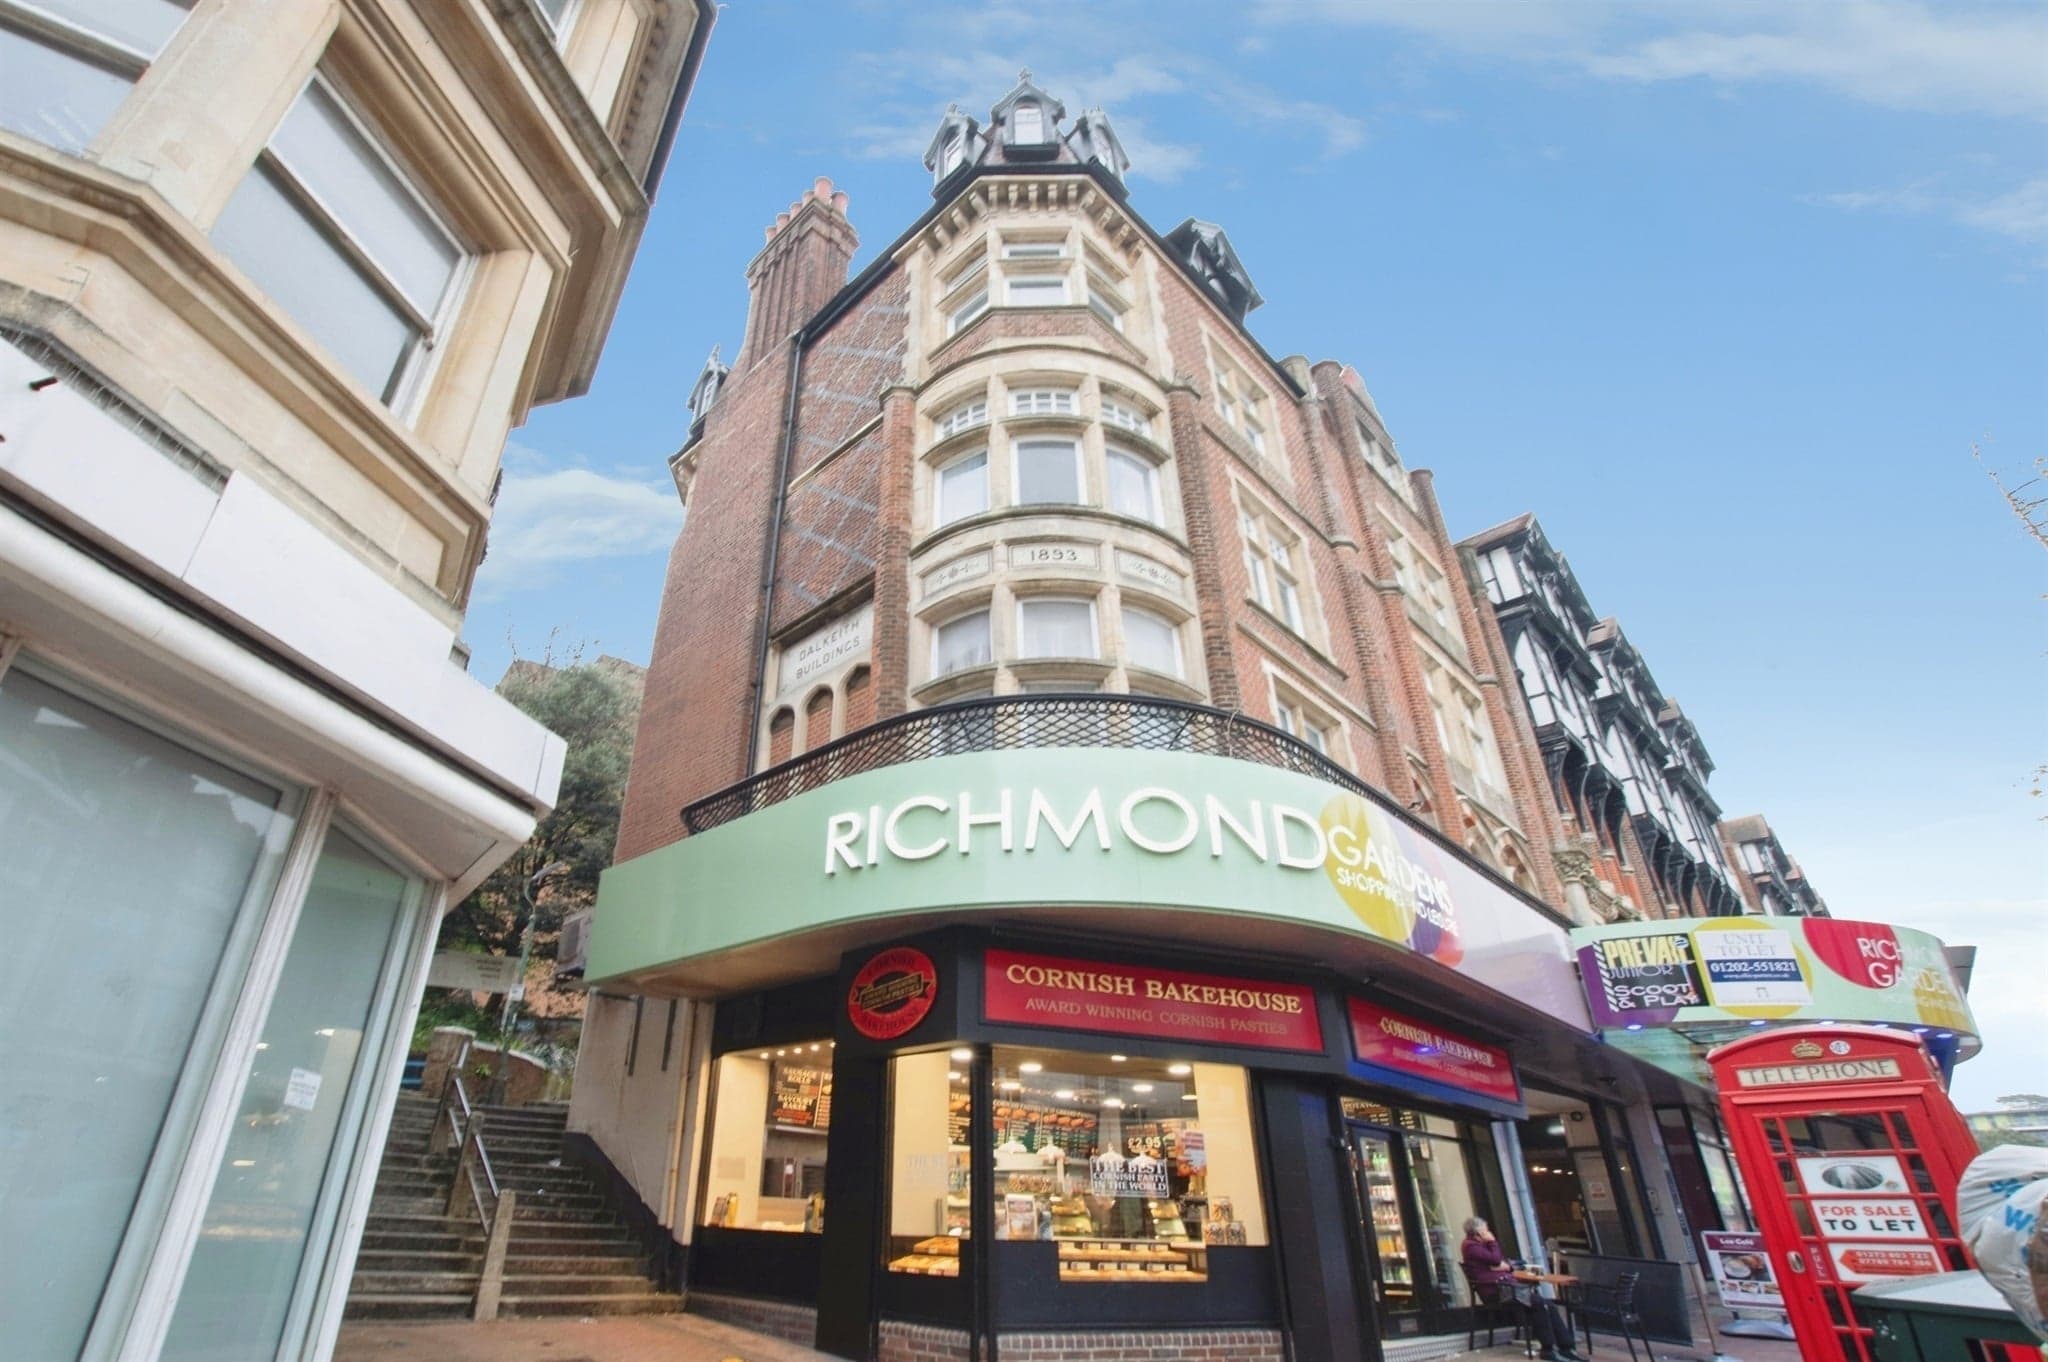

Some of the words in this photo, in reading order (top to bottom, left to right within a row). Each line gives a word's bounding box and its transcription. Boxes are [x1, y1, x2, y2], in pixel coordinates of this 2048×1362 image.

[1029, 550, 1078, 562] 1893
[799, 620, 860, 661] DALKEITH
[796, 635, 861, 679] BUILDINGS
[825, 786, 1328, 877] RICHMOND
[1723, 932, 1768, 945] UNIT
[1718, 945, 1747, 957] TO
[1748, 944, 1777, 957] LET
[1711, 960, 1797, 974] 01202-551821
[1006, 963, 1136, 997] CORNISH
[1144, 980, 1304, 1014] BAKEHOUSE
[1614, 983, 1690, 997] SCOOT
[1618, 996, 1637, 1009] &
[1025, 998, 1081, 1015] AWARD
[1086, 1005, 1153, 1022] WINNING
[1159, 1011, 1226, 1030] CORNISH
[1231, 1019, 1288, 1036] PASTIES
[1380, 1017, 1432, 1048] CORNISH
[1745, 1060, 1893, 1084] TELEPHONE
[1127, 1136, 1162, 1150] £2.95
[1095, 1159, 1125, 1173] THE
[1127, 1158, 1165, 1174] BEST
[1109, 1181, 1128, 1191] THE
[1129, 1181, 1167, 1192] WORLD
[1820, 1205, 1857, 1217] FOR
[1862, 1205, 1913, 1217] SALE
[1824, 1218, 1857, 1231] TO
[1869, 1218, 1917, 1232] LET
